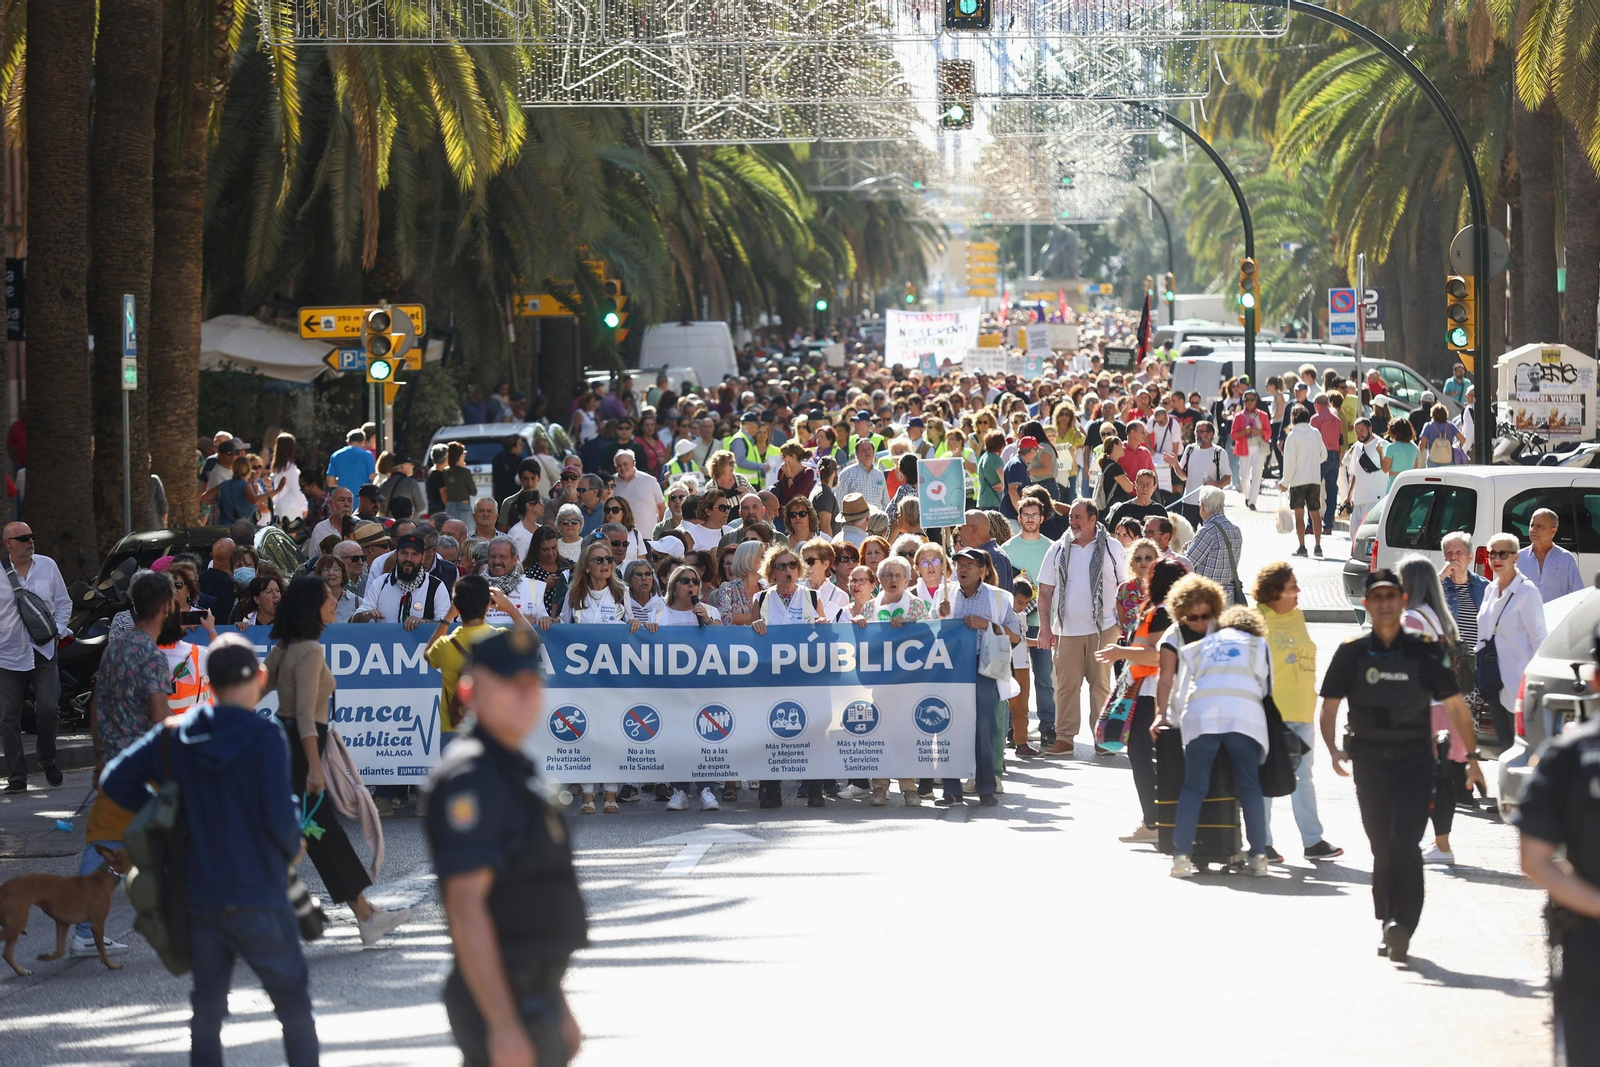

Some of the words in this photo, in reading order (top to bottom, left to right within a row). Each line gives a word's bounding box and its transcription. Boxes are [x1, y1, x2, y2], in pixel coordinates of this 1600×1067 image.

[537, 643, 556, 675] A
[565, 643, 759, 676] SANIDAD
[771, 631, 954, 675] PÚBLICA
[765, 742, 779, 750] Más
[859, 740, 885, 748] Mejores
[768, 757, 808, 765] Condiciones
[781, 765, 806, 773] Trabajo
[692, 770, 738, 778] Interminables
